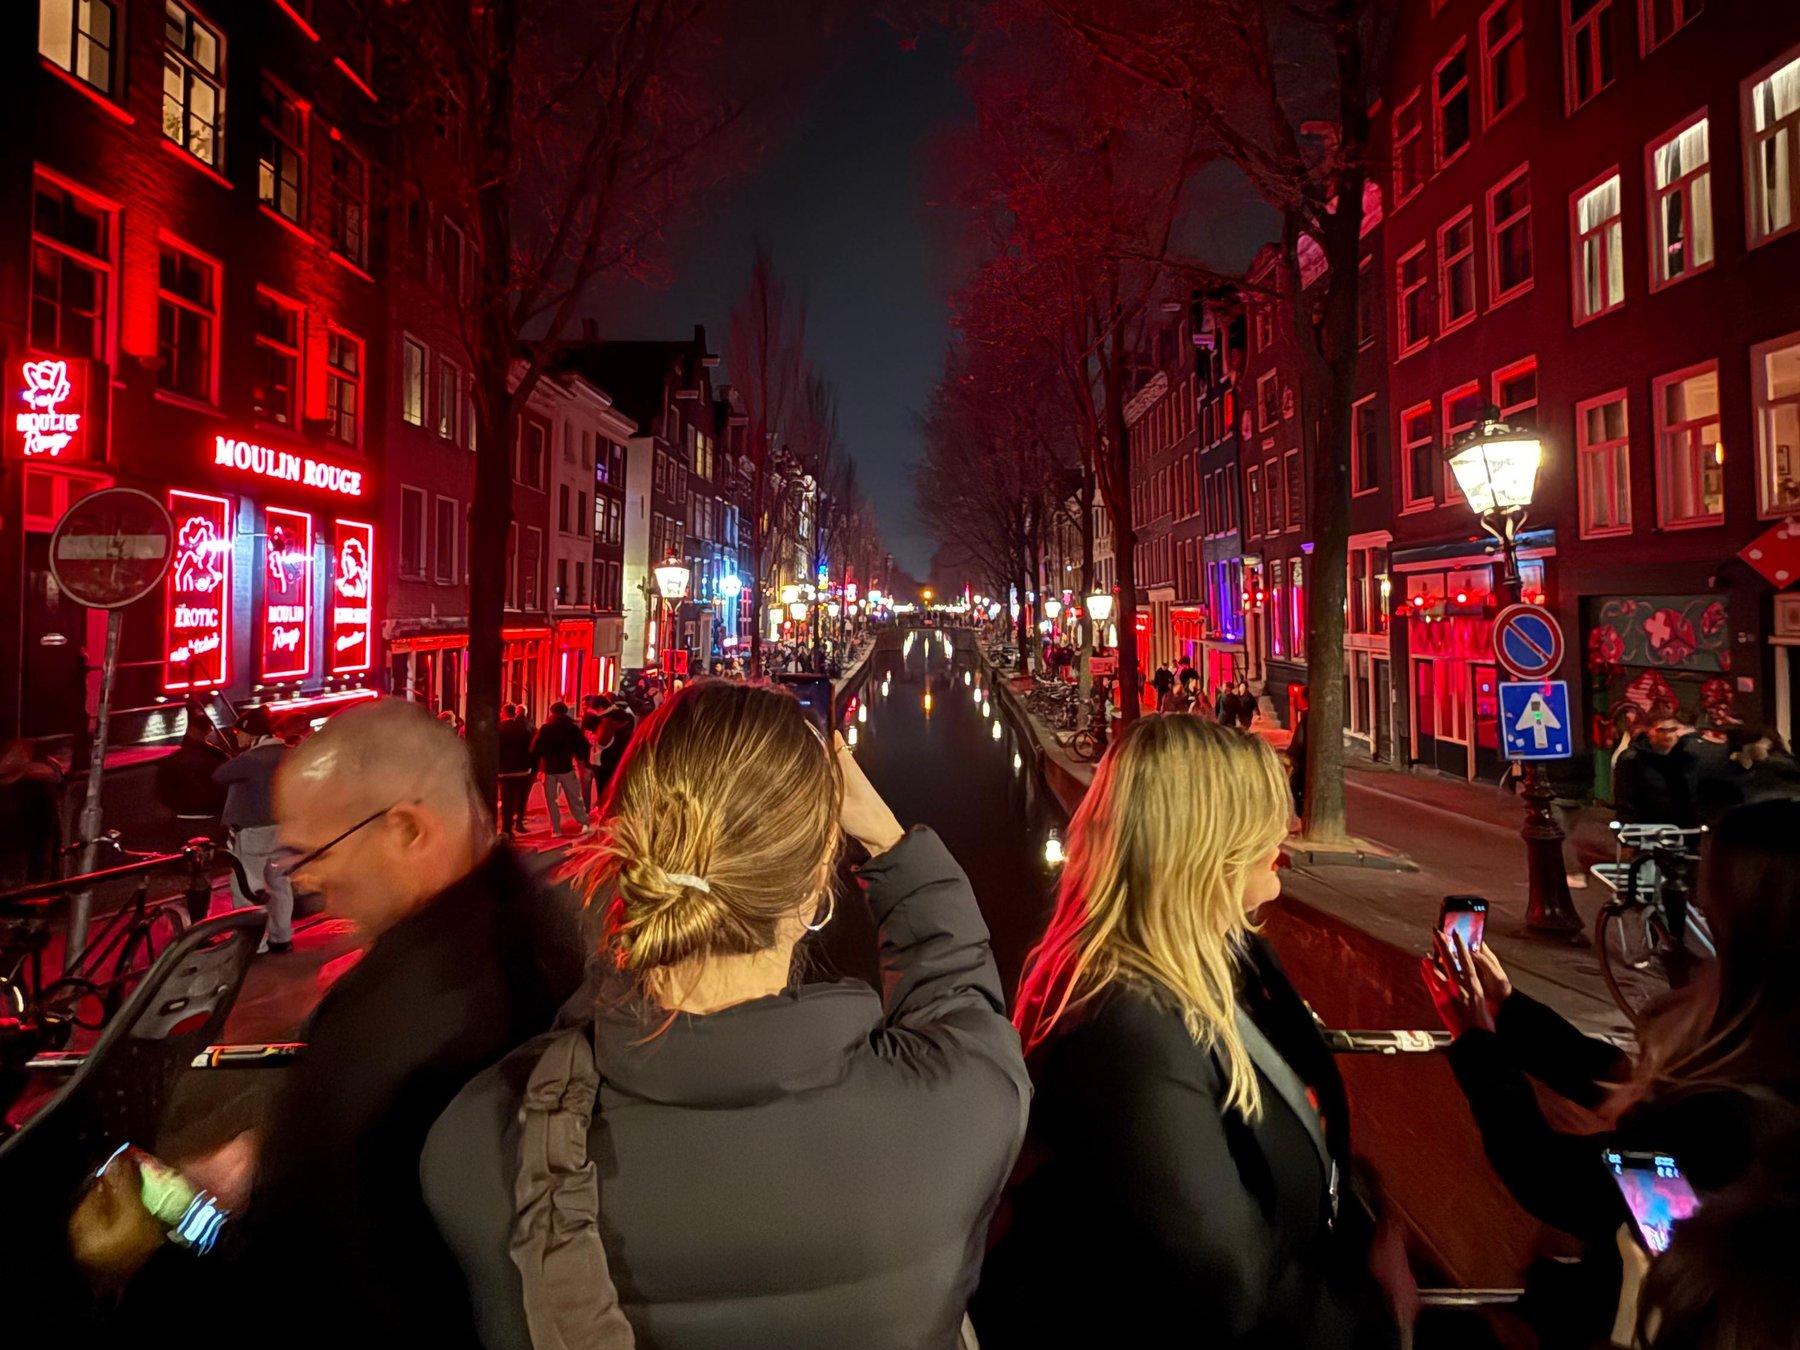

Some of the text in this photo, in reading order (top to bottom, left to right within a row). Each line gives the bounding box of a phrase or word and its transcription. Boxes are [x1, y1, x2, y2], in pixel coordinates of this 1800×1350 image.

[214, 436, 361, 496] MOULIN ROUGE
[174, 607, 219, 628] EROTIC
